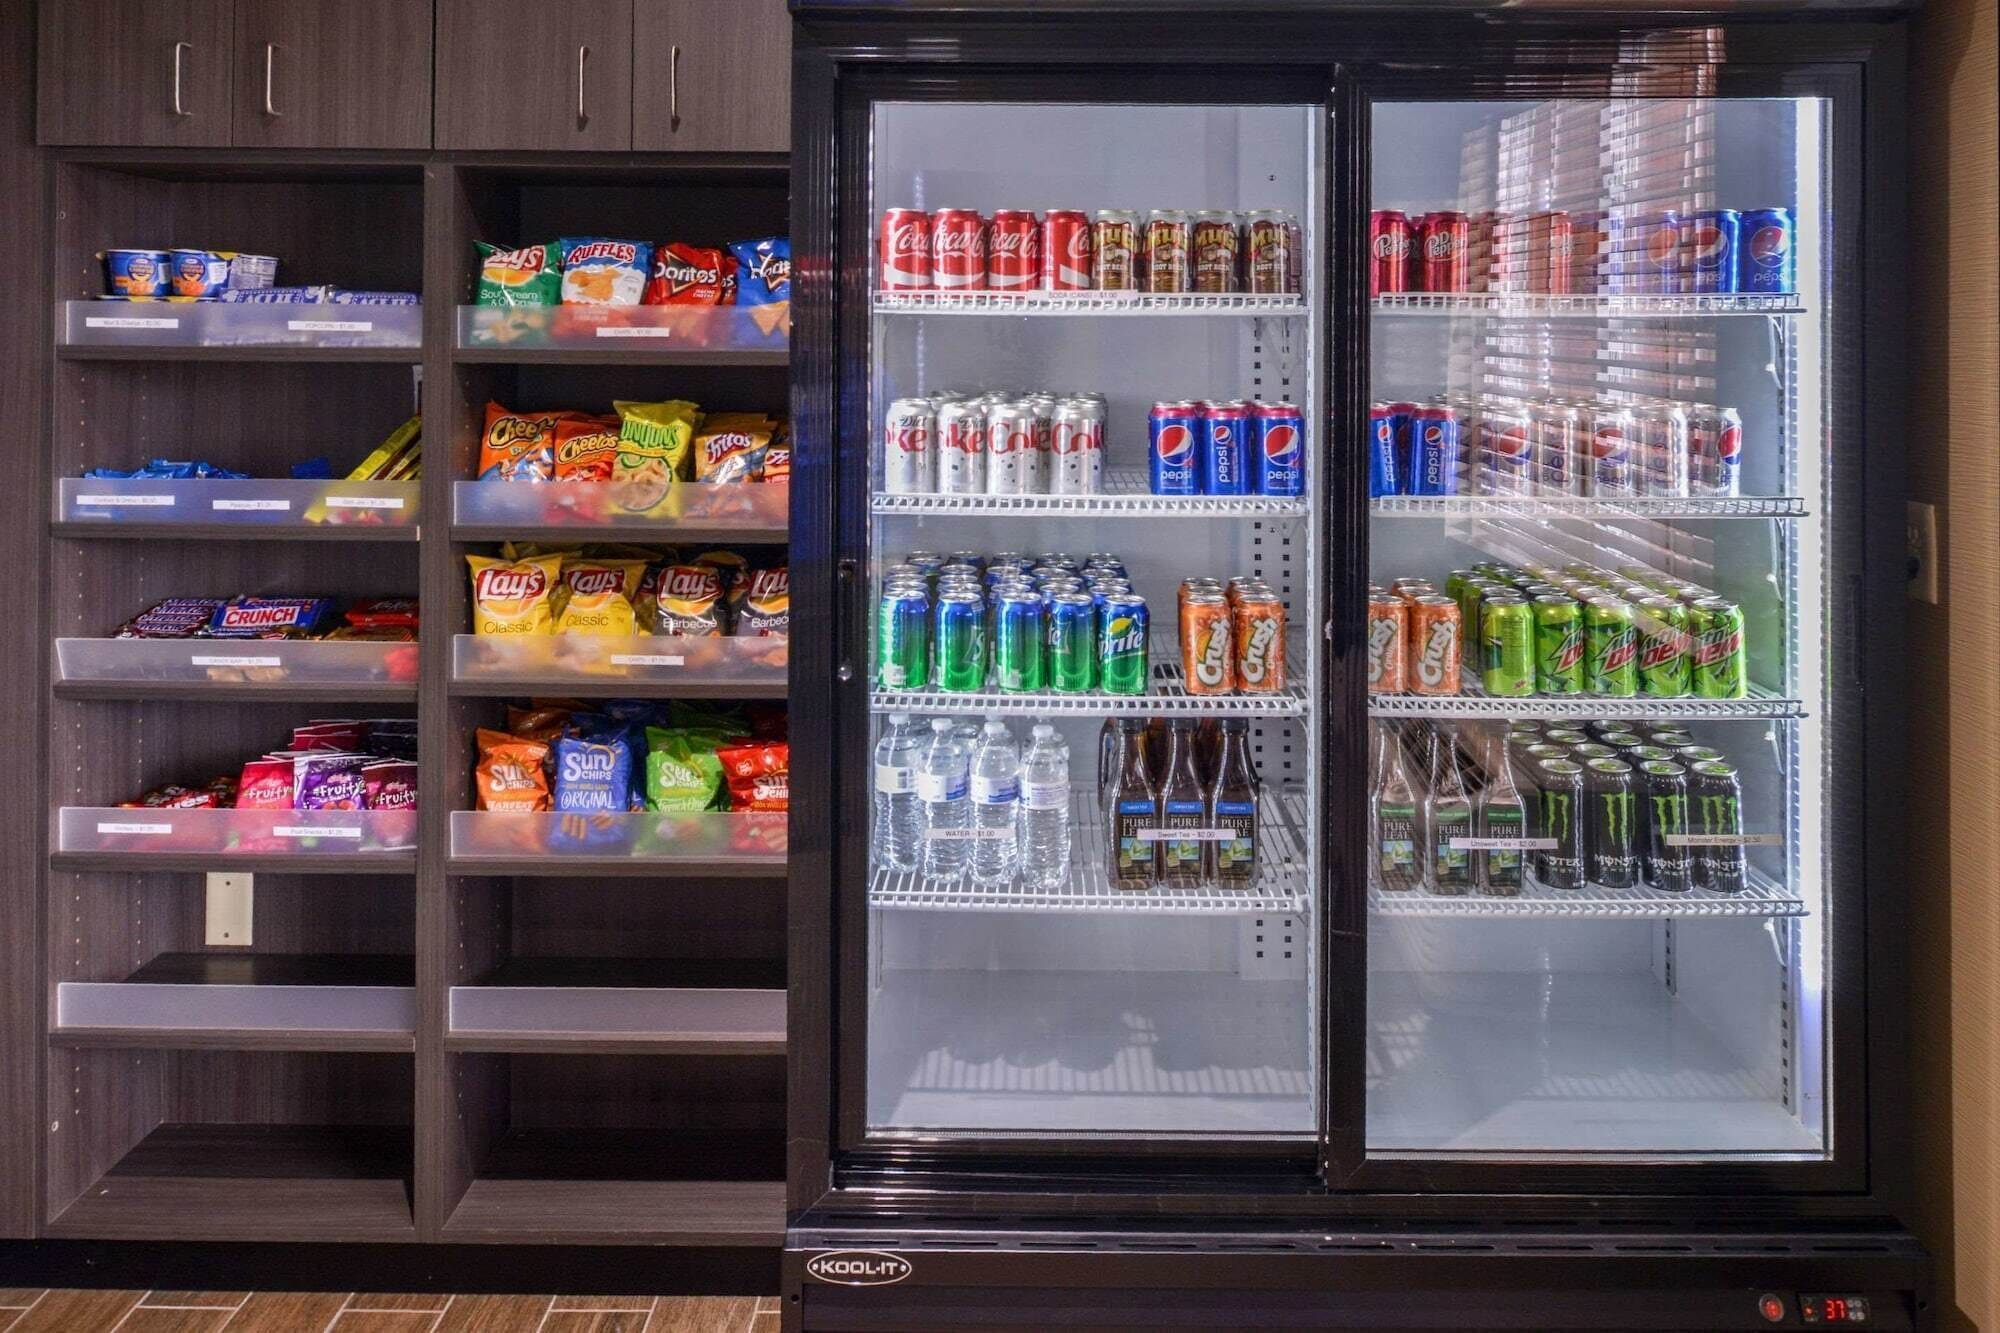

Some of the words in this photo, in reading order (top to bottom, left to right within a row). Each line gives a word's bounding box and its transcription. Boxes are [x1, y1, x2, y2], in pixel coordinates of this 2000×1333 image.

[567, 242, 636, 265] RUFFLES
[654, 261, 717, 284] Doritos
[481, 289, 502, 299] Sour
[559, 433, 619, 462] Cheetos
[707, 431, 751, 464] Fritos
[1216, 446, 1231, 483] pepsi
[1426, 447, 1440, 485] pepsi
[1160, 470, 1192, 482] pepsi
[1268, 470, 1299, 482] pepsi
[225, 607, 296, 625] CRUNCH
[484, 620, 533, 634] Classic
[1197, 618, 1231, 686] Crush
[1242, 617, 1278, 684] Crush
[1417, 620, 1457, 686] Crush
[582, 770, 612, 780] CHIPS
[561, 790, 616, 810] ORIGINAL
[1122, 817, 1153, 828] PURE
[1170, 817, 1199, 827] PURE
[1221, 818, 1251, 828] PURE
[1383, 821, 1414, 832] PURE
[945, 830, 970, 838] WATER
[977, 830, 995, 838] $1.00
[1158, 831, 1178, 839] Sweet
[1179, 831, 1190, 839] Tea
[1439, 825, 1466, 834] PURE
[1490, 825, 1520, 835] PURE
[1471, 839, 1498, 848] Unsweet
[1500, 840, 1510, 848] Tea
[820, 1260, 898, 1275] KOOL-IT
[1826, 1300, 1845, 1319] 37
